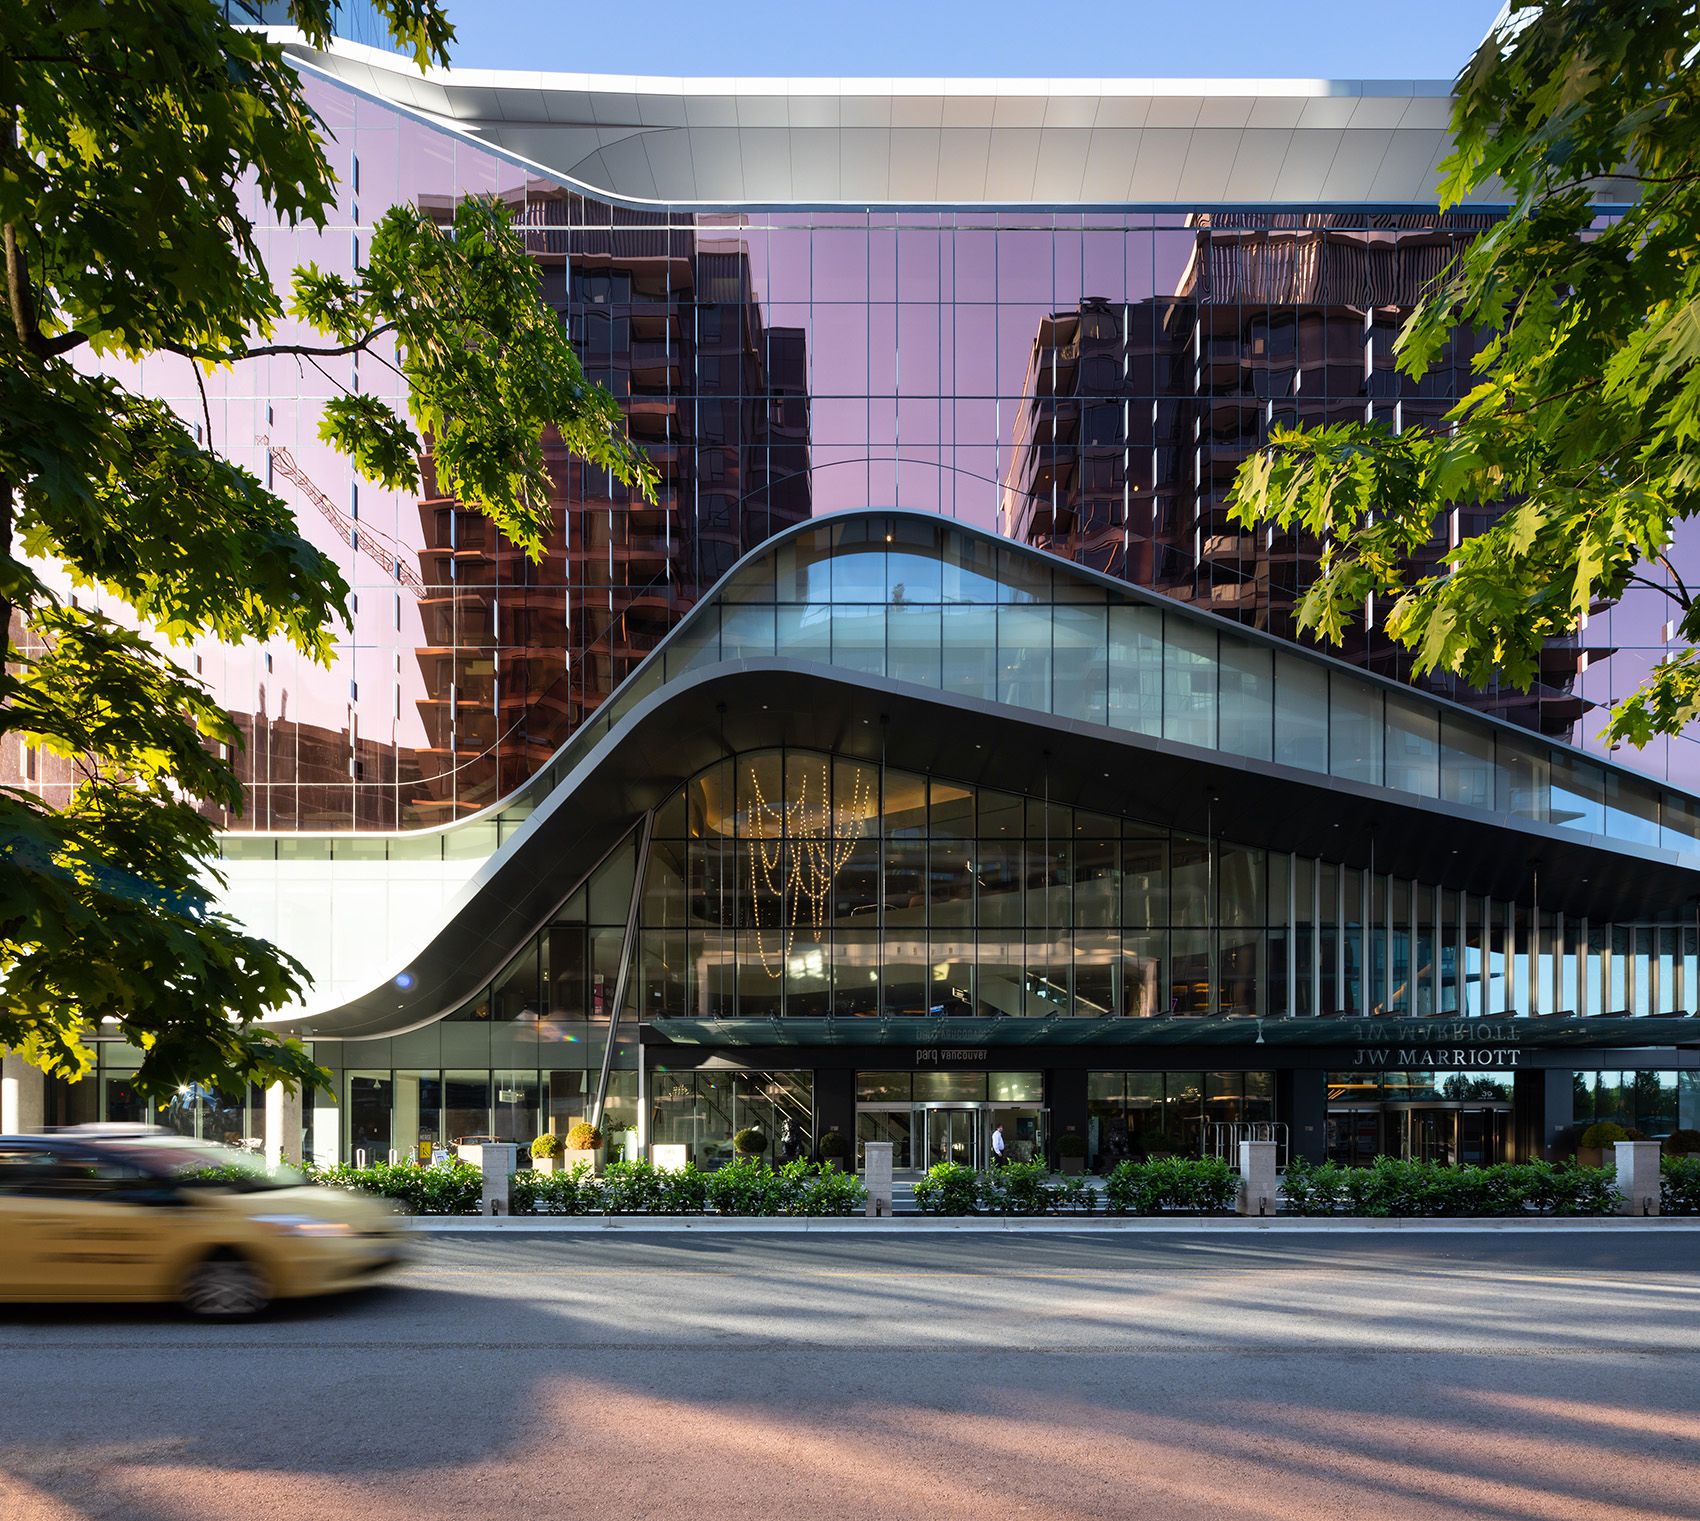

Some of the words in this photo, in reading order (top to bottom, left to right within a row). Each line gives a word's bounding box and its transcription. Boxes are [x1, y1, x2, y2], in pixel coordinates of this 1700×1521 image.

[916, 1049, 938, 1064] parq
[941, 1050, 988, 1060] vancouver
[1353, 1049, 1390, 1065] JW
[1398, 1049, 1521, 1065] MARRIOTT
